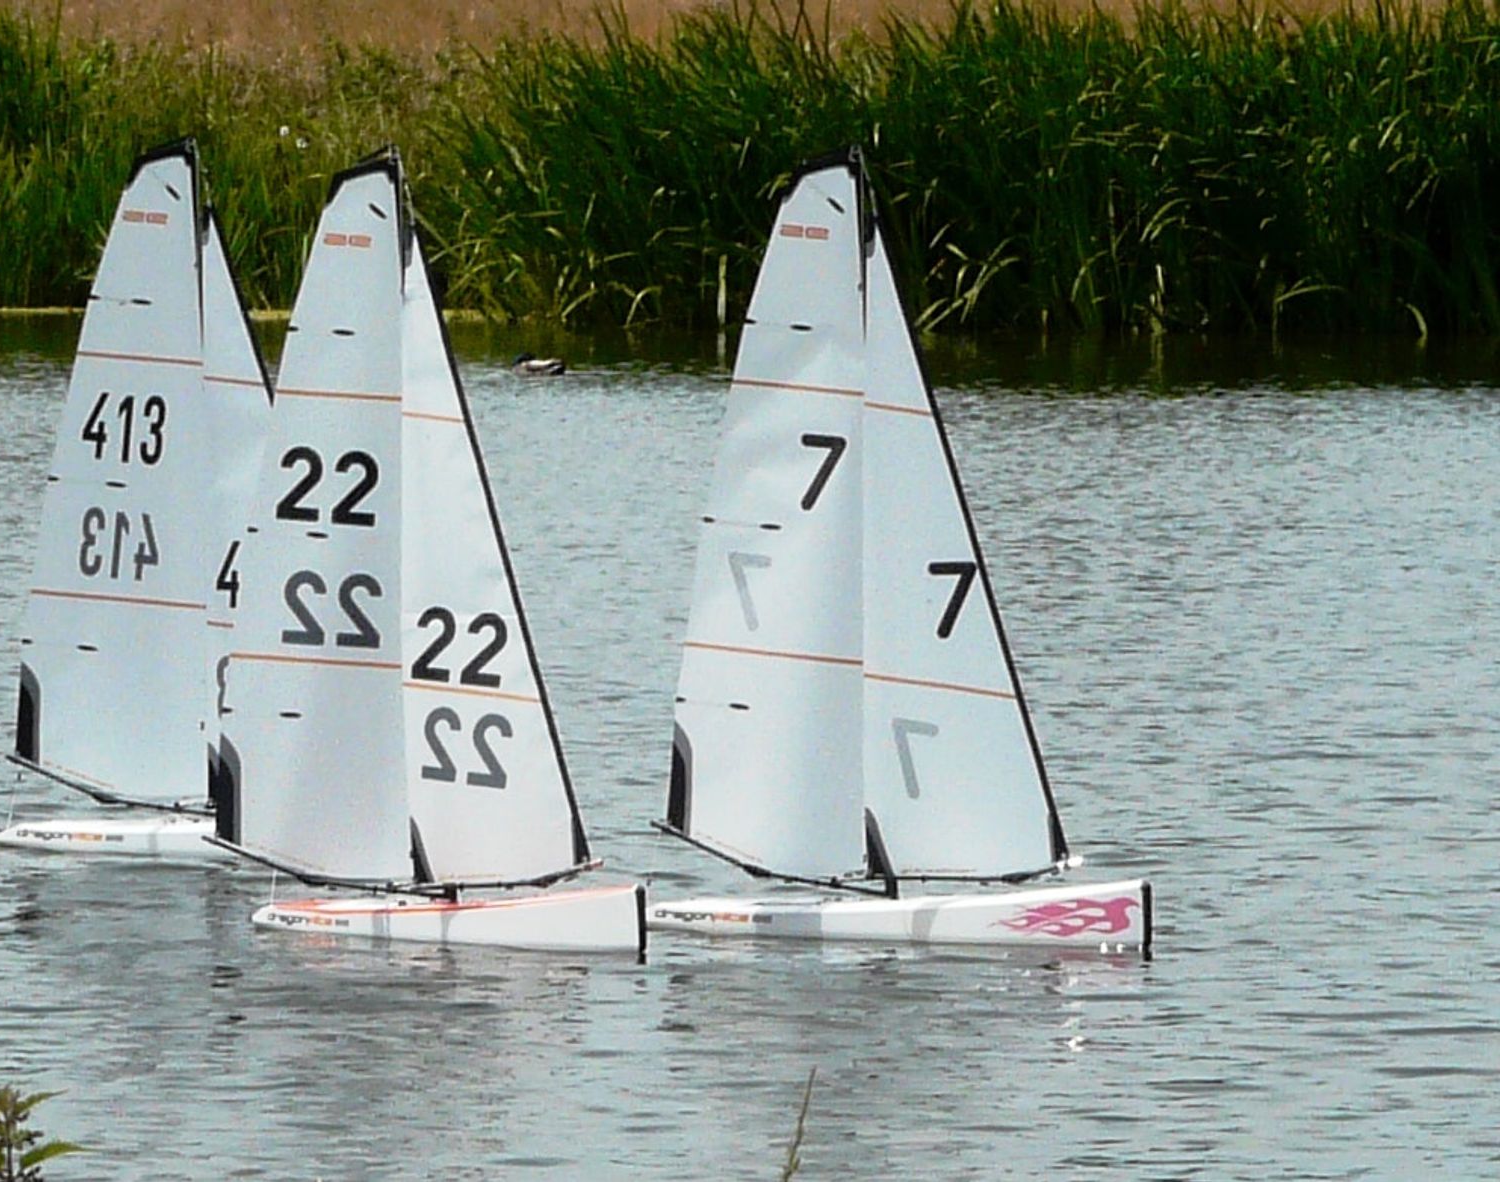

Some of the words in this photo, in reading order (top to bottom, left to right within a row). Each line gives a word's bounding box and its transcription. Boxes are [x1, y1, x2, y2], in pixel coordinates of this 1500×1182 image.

[82, 392, 166, 465] 413
[275, 446, 379, 527] 22
[801, 433, 847, 511] 7
[927, 561, 976, 639] 7
[410, 606, 508, 688] 22
